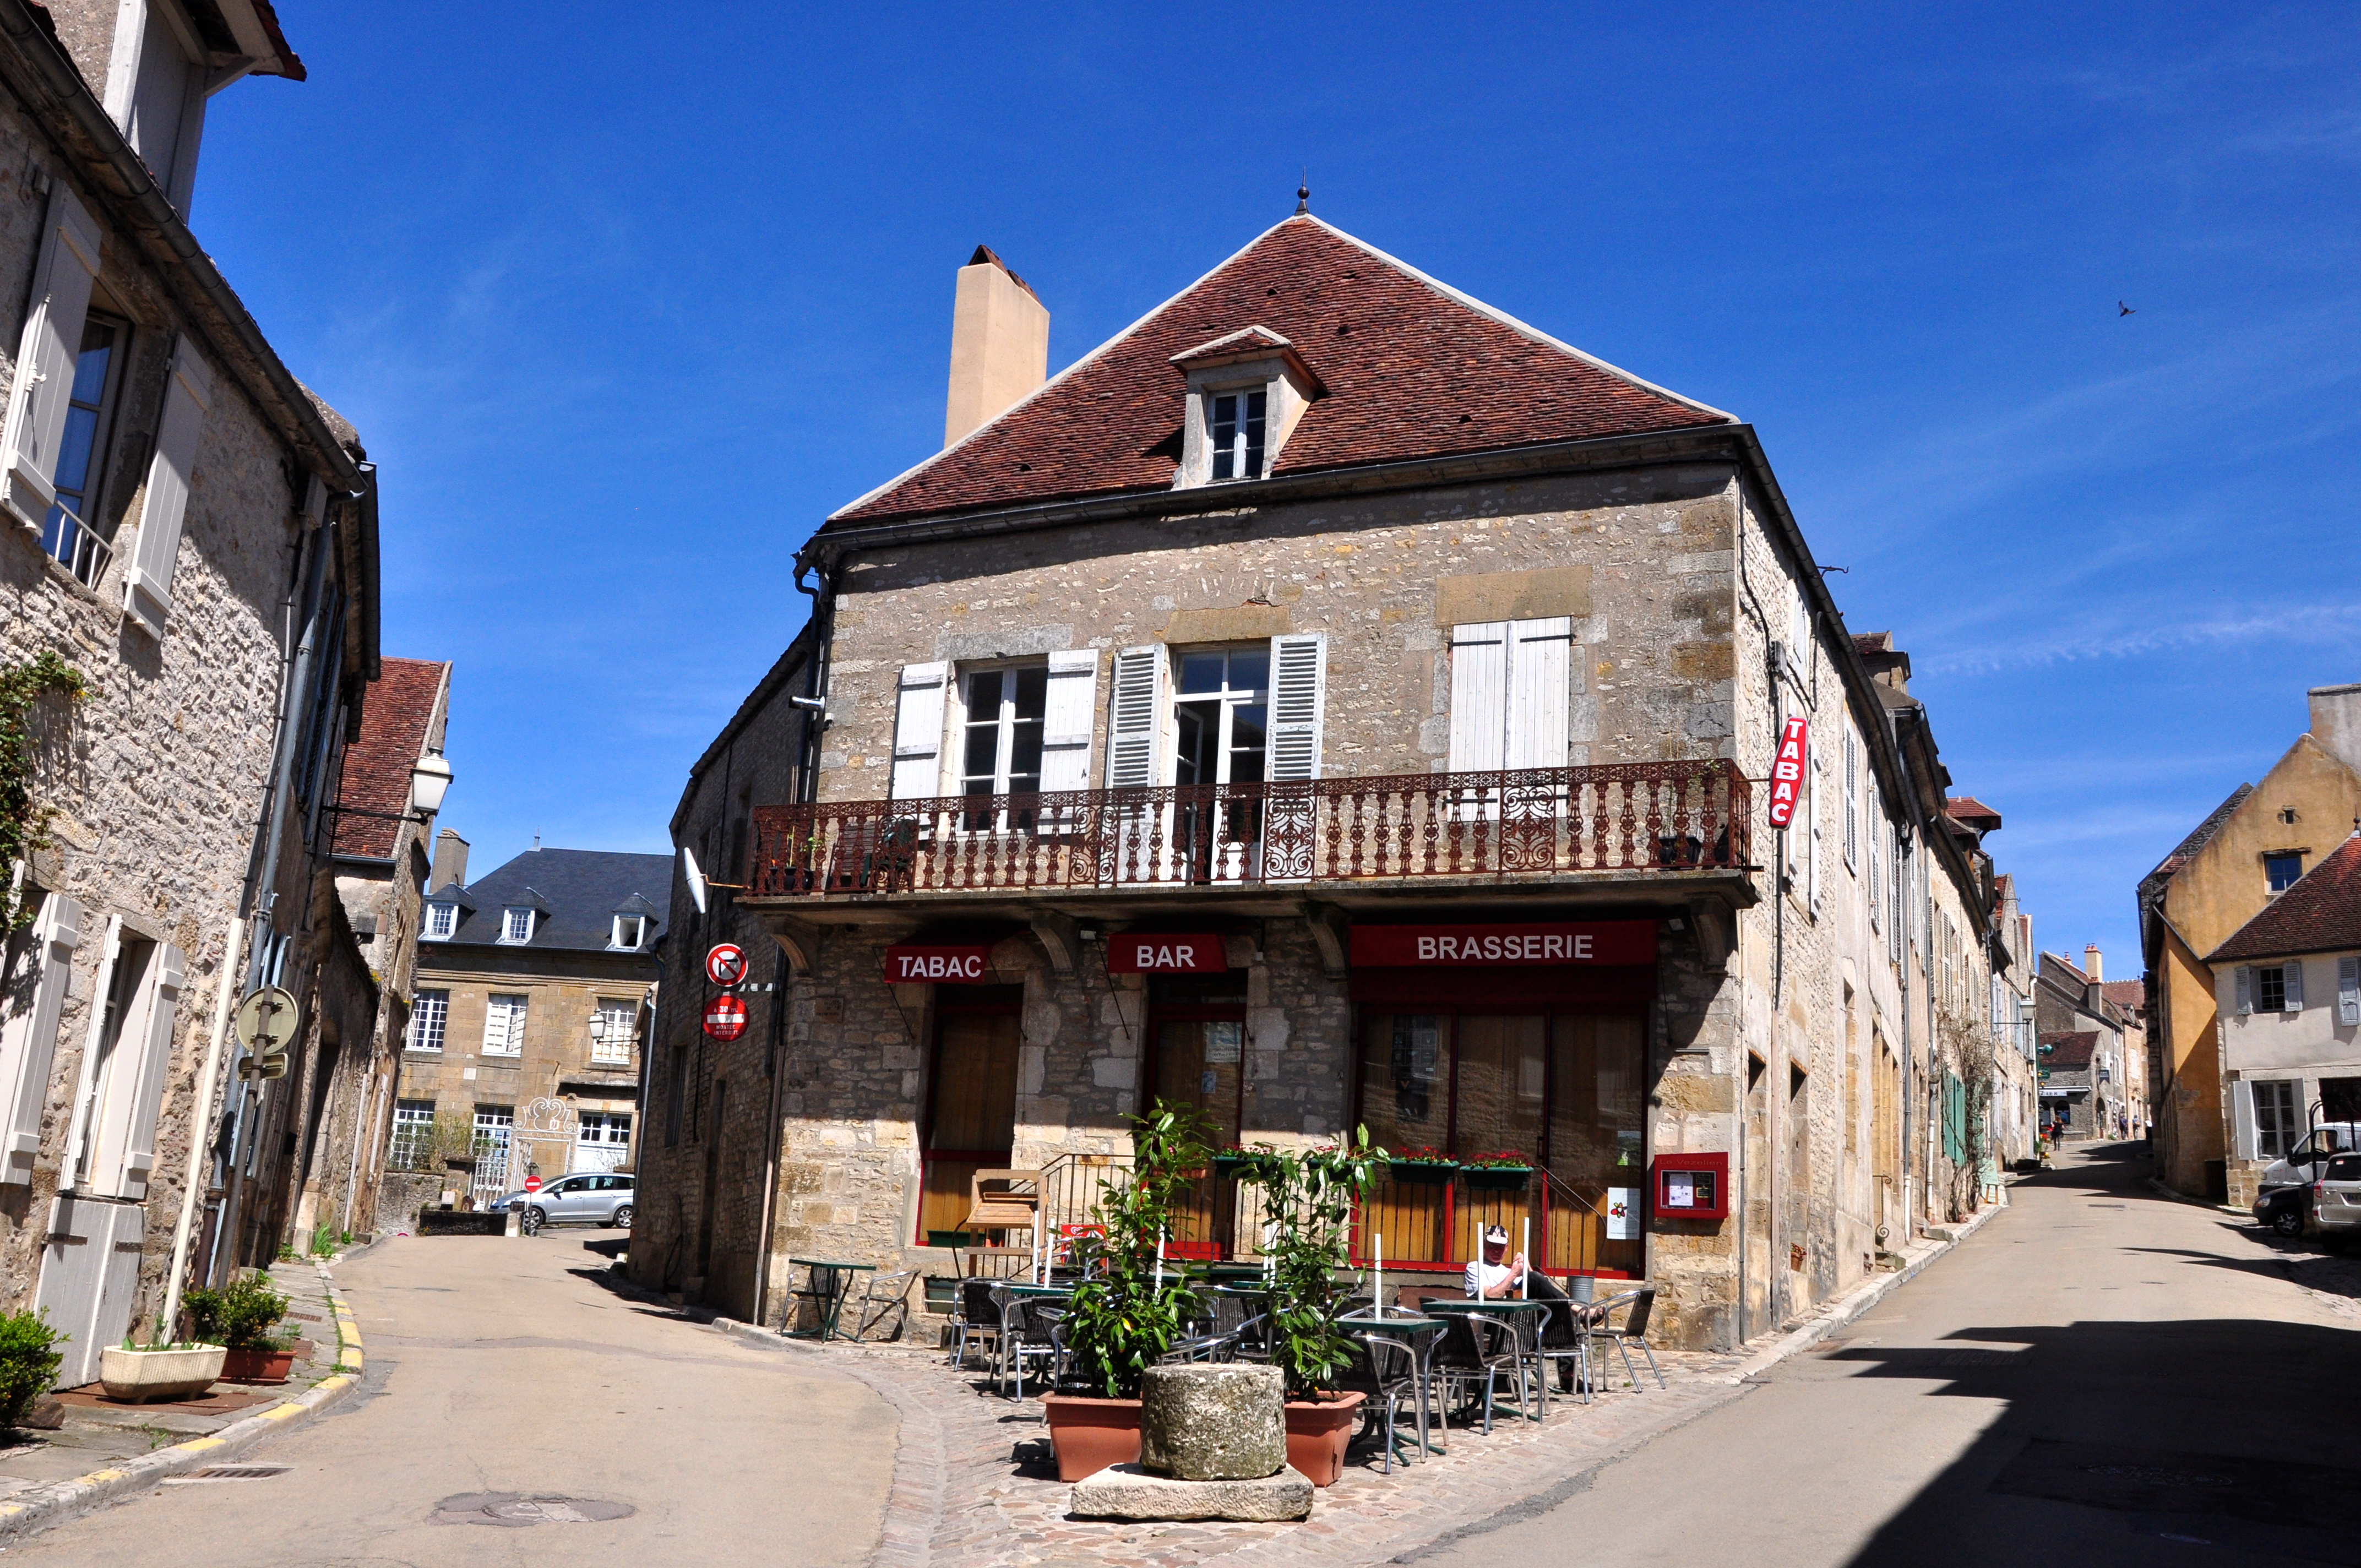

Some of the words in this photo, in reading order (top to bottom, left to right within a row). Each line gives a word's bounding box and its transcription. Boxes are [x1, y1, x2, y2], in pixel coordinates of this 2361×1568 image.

[1771, 721, 1803, 821] TABAC
[1137, 945, 1196, 967] BAR
[1418, 935, 1593, 960] BRASSERIE
[898, 956, 981, 978] TABAC
